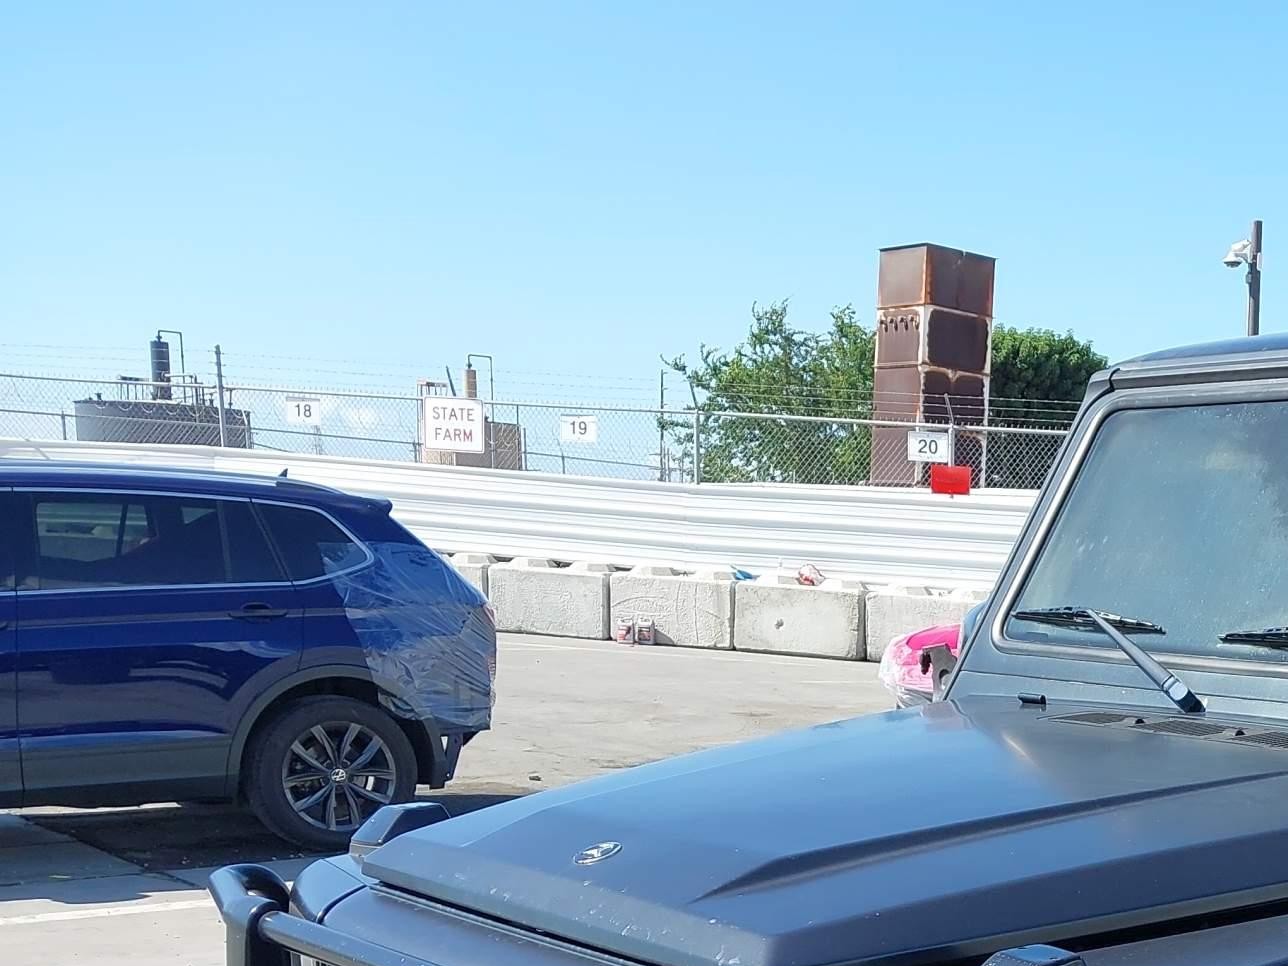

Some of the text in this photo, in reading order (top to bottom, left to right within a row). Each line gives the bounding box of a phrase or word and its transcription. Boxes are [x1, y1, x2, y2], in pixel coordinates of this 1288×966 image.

[295, 403, 312, 418] 18
[432, 406, 475, 422] STATE
[434, 427, 473, 442] FARM
[570, 420, 587, 435] 19
[918, 438, 938, 454] 20
